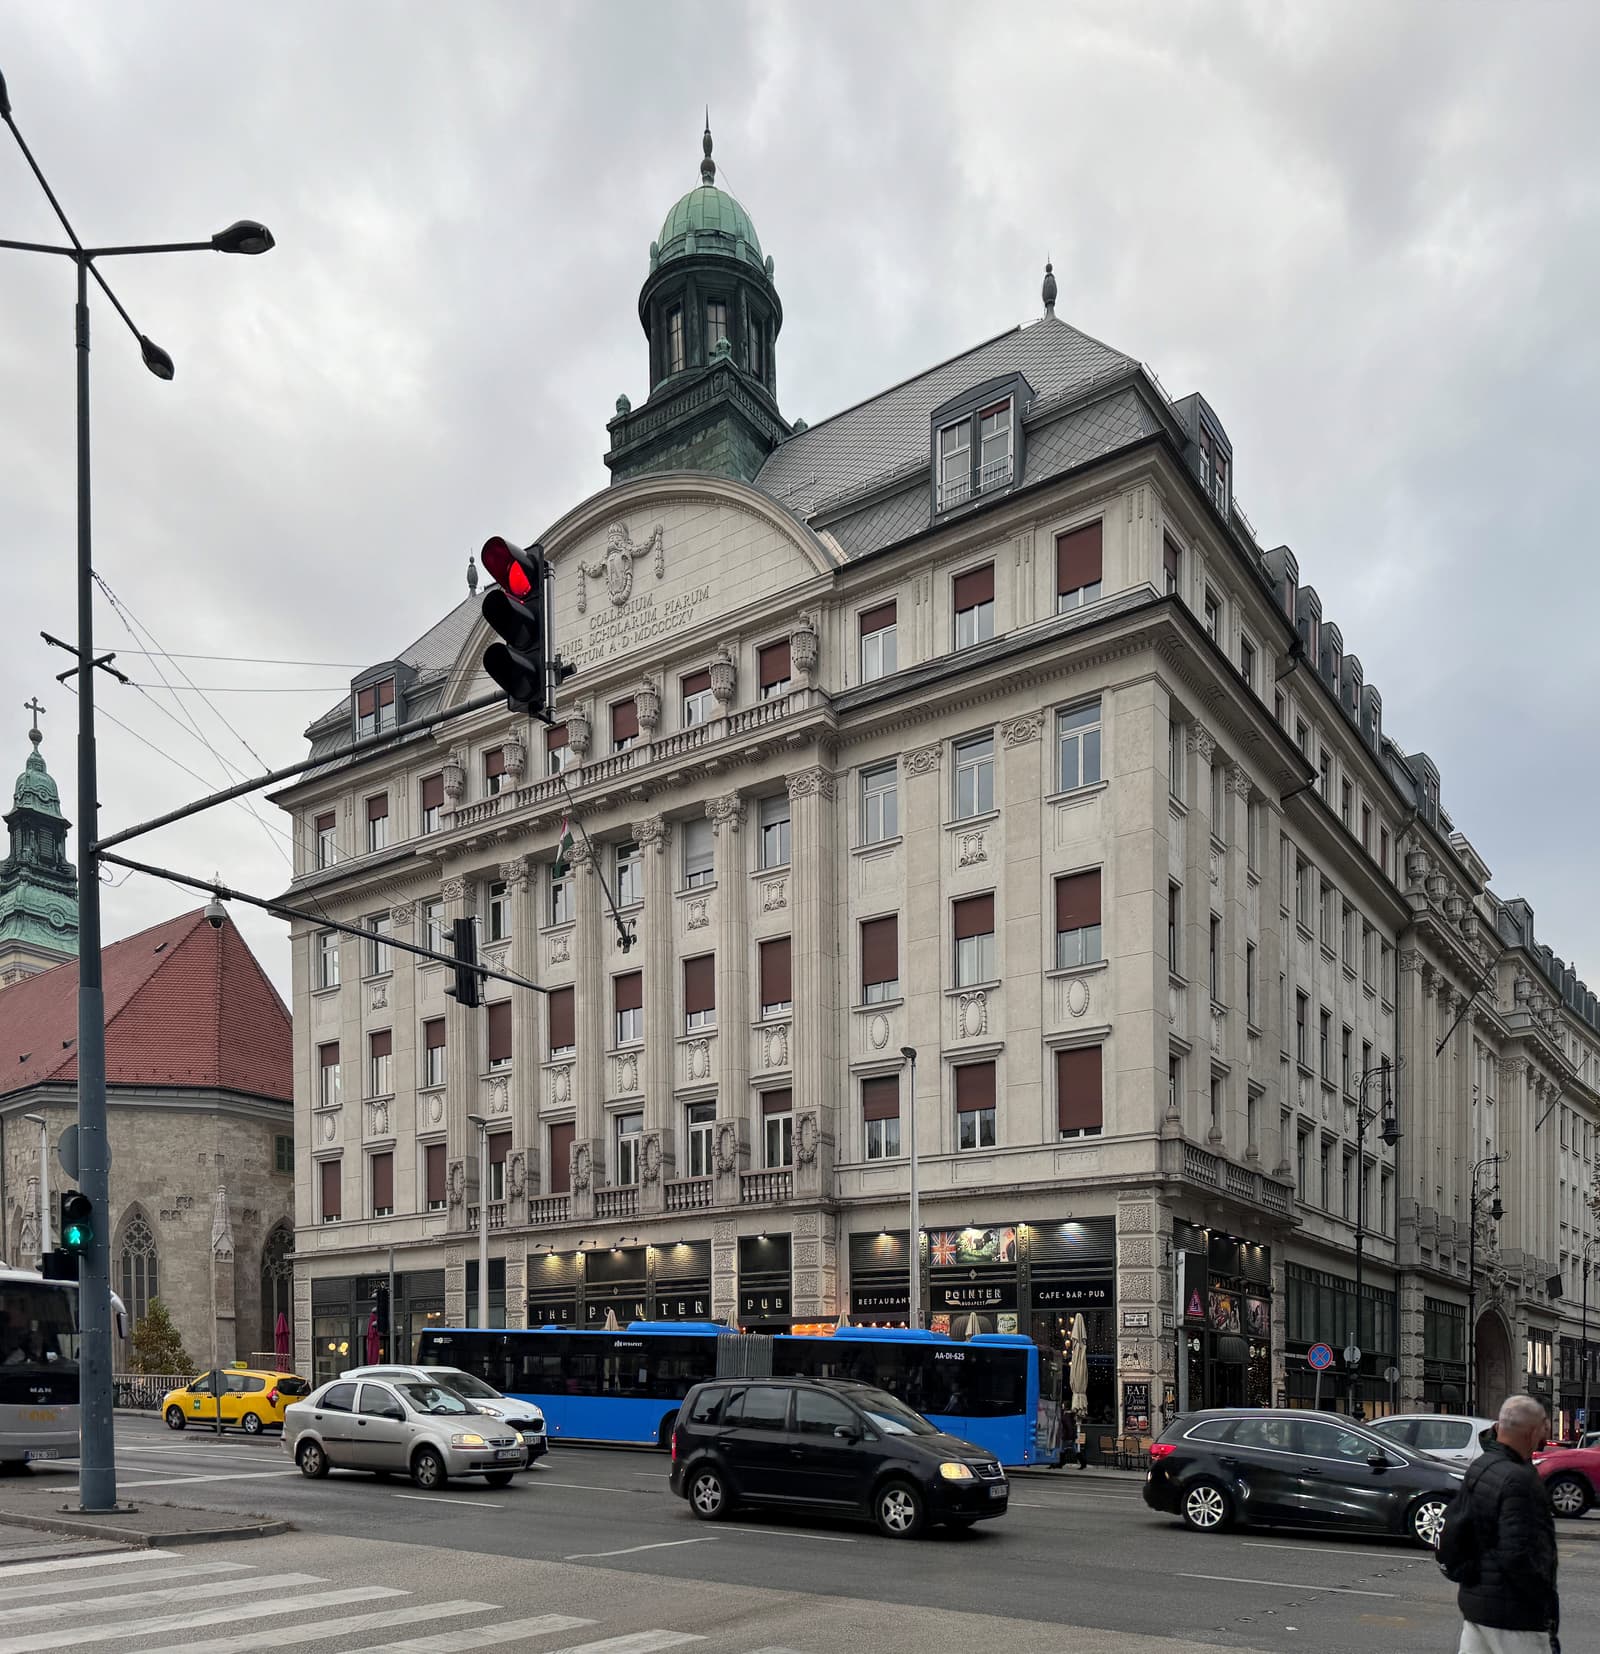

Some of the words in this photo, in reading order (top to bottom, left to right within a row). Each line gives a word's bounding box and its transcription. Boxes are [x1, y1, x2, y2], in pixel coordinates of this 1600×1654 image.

[589, 607, 657, 647] SCHOLARUM
[664, 585, 710, 616] PIARUM
[590, 593, 653, 630] COLLEGIUM
[945, 1288, 1002, 1300] POINTER
[538, 1309, 568, 1321] THE
[747, 1298, 783, 1310] PUB
[1126, 1385, 1148, 1395] EAT
